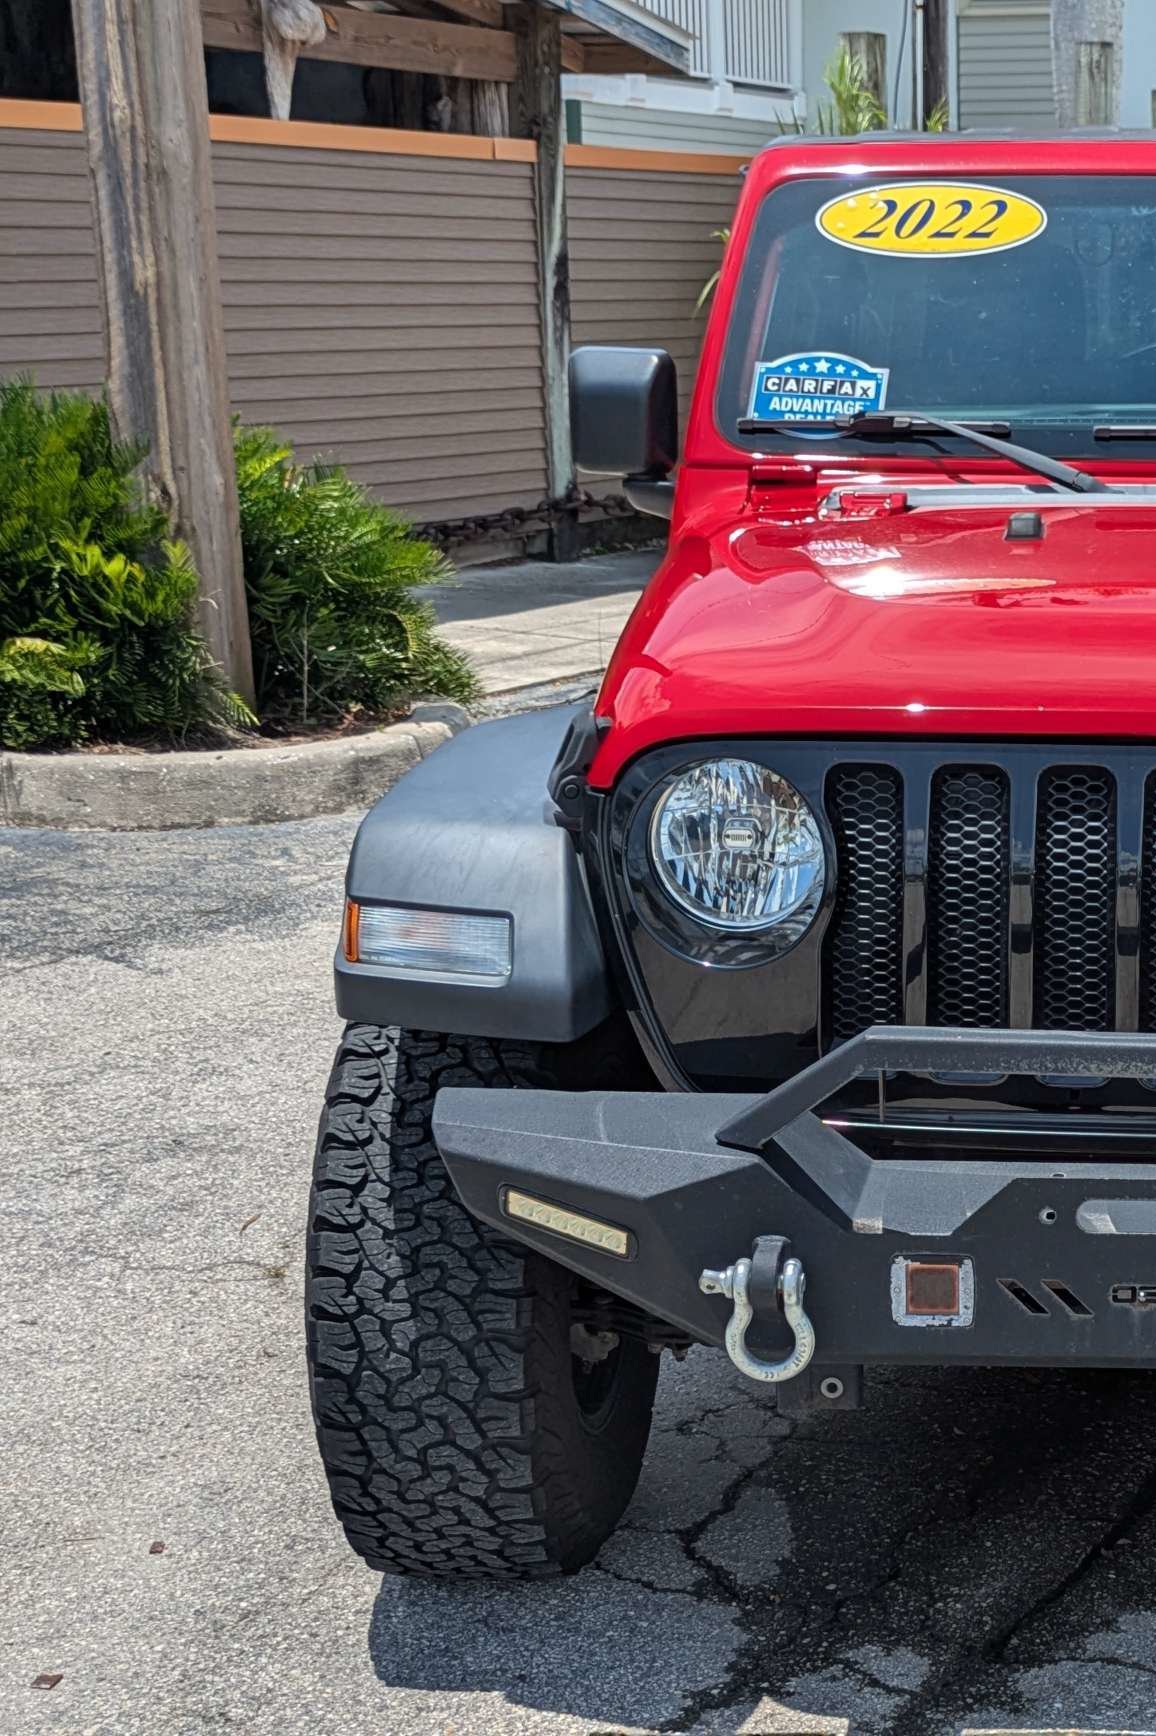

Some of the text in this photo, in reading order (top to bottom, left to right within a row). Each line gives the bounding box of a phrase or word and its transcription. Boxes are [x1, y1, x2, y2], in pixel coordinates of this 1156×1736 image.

[853, 199, 1008, 239] 2022
[765, 377, 872, 398] CARFAX
[769, 397, 864, 415] ADVANTAGE
